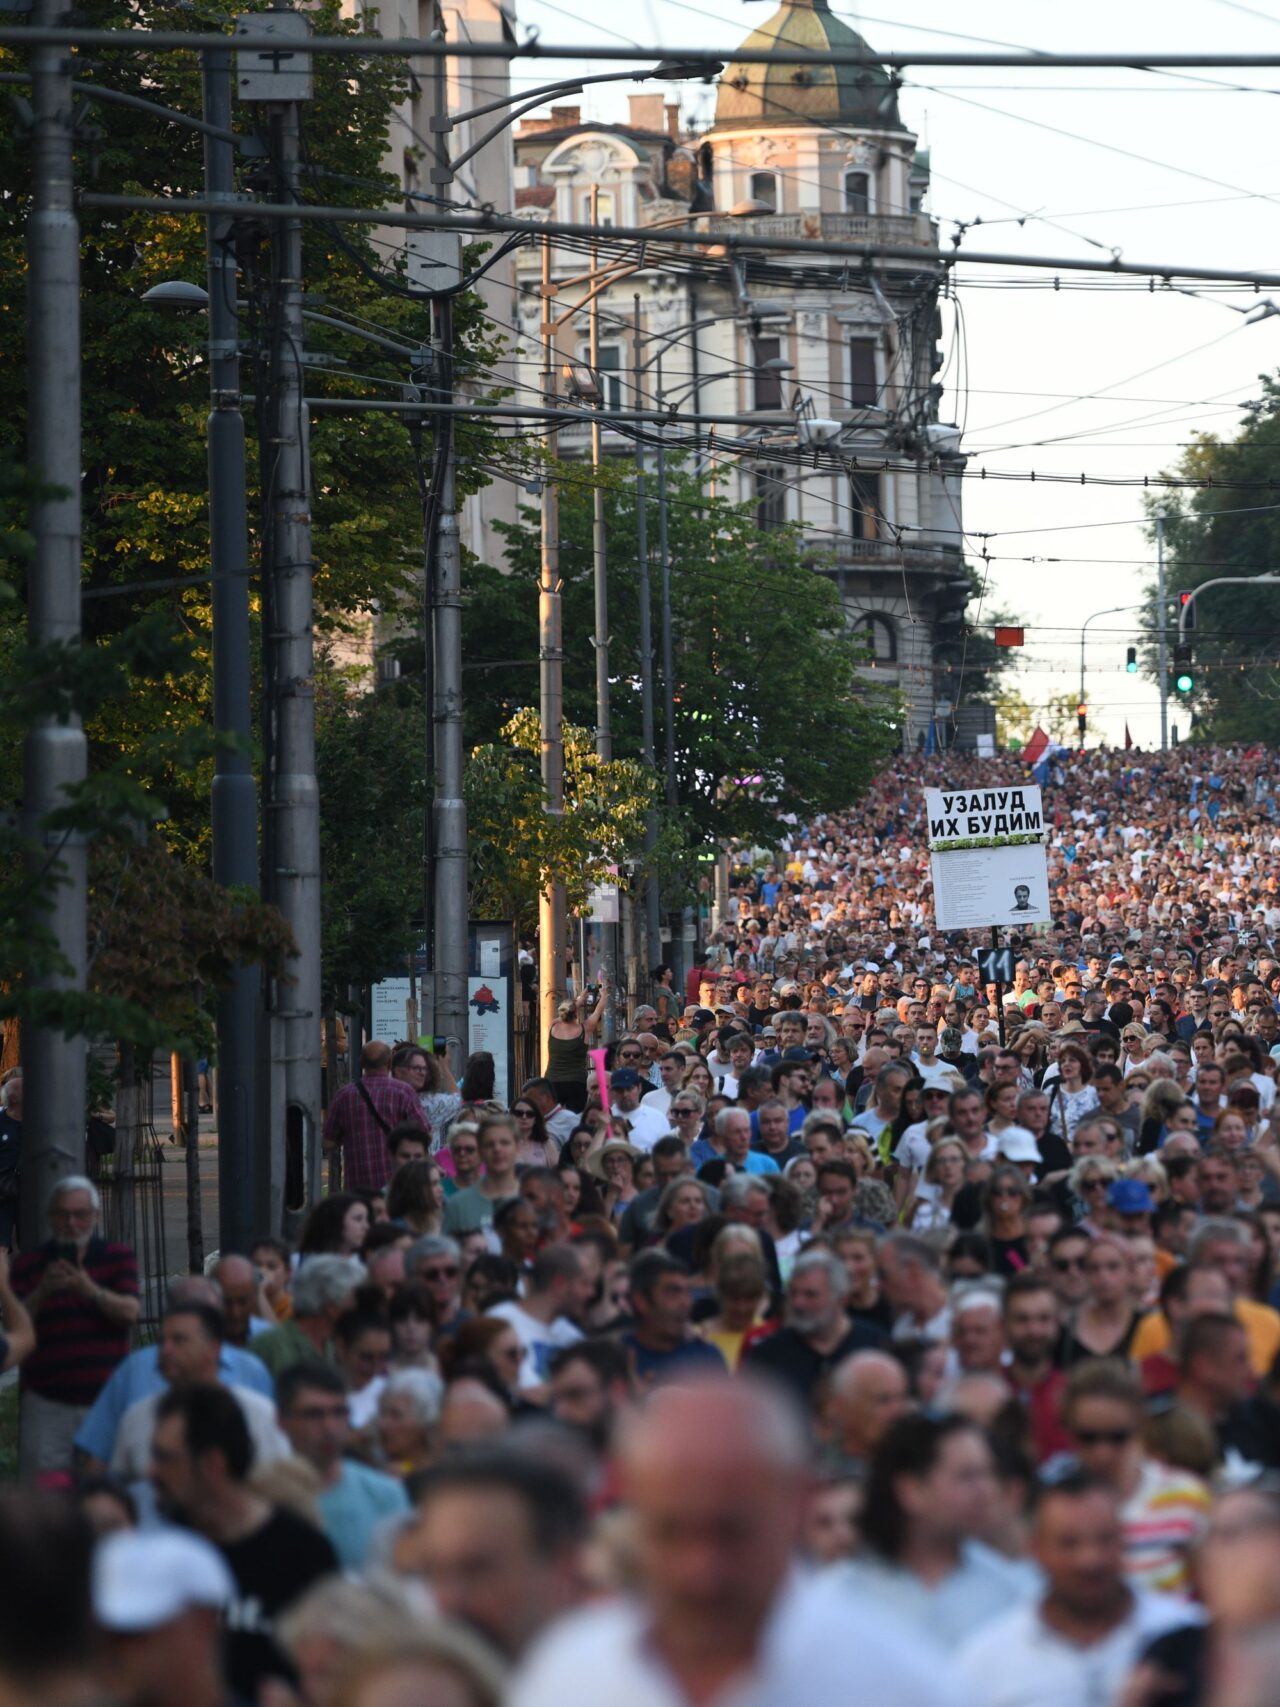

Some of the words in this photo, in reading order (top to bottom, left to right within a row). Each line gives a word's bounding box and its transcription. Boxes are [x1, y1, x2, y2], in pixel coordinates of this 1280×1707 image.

[943, 791, 1025, 814] УЗАЛУД
[931, 818, 960, 837] ИХ
[968, 812, 1041, 835] БУДИМ
[981, 950, 1010, 981] 11
